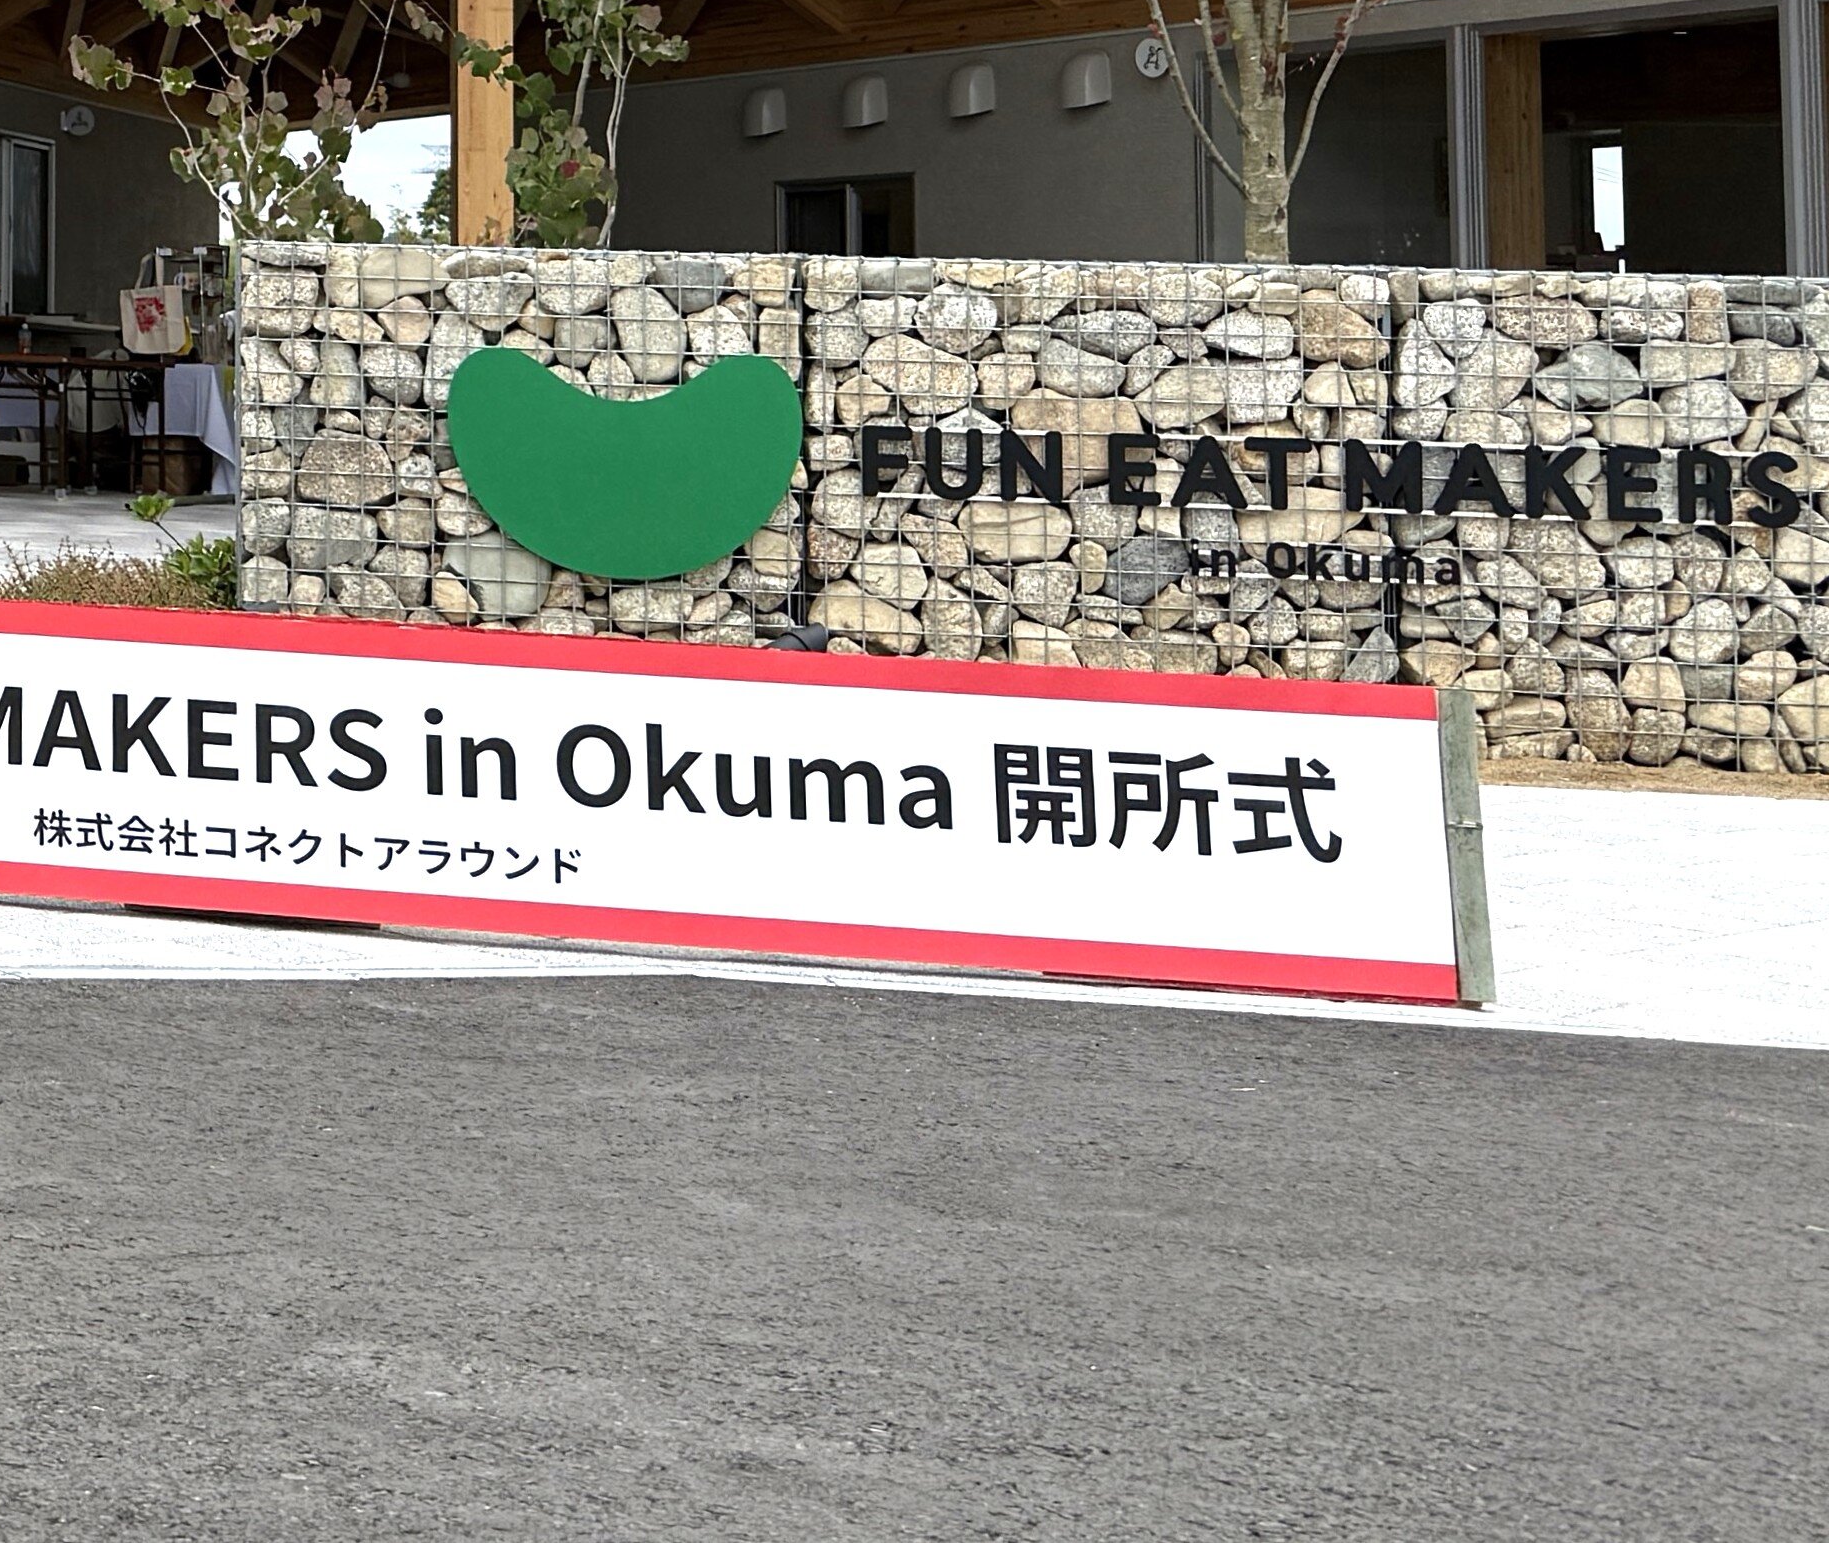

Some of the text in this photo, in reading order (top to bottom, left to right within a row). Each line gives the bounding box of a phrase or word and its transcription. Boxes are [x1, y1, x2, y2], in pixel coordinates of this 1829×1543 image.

[860, 425, 1801, 528] FUN EAT MAKERS
[1191, 538, 1461, 585] in Okuma
[425, 707, 517, 801] in
[556, 722, 953, 831] Okuma
[993, 743, 1343, 864] 開所式
[33, 808, 582, 885] 株式会社コネクトアラウンド
